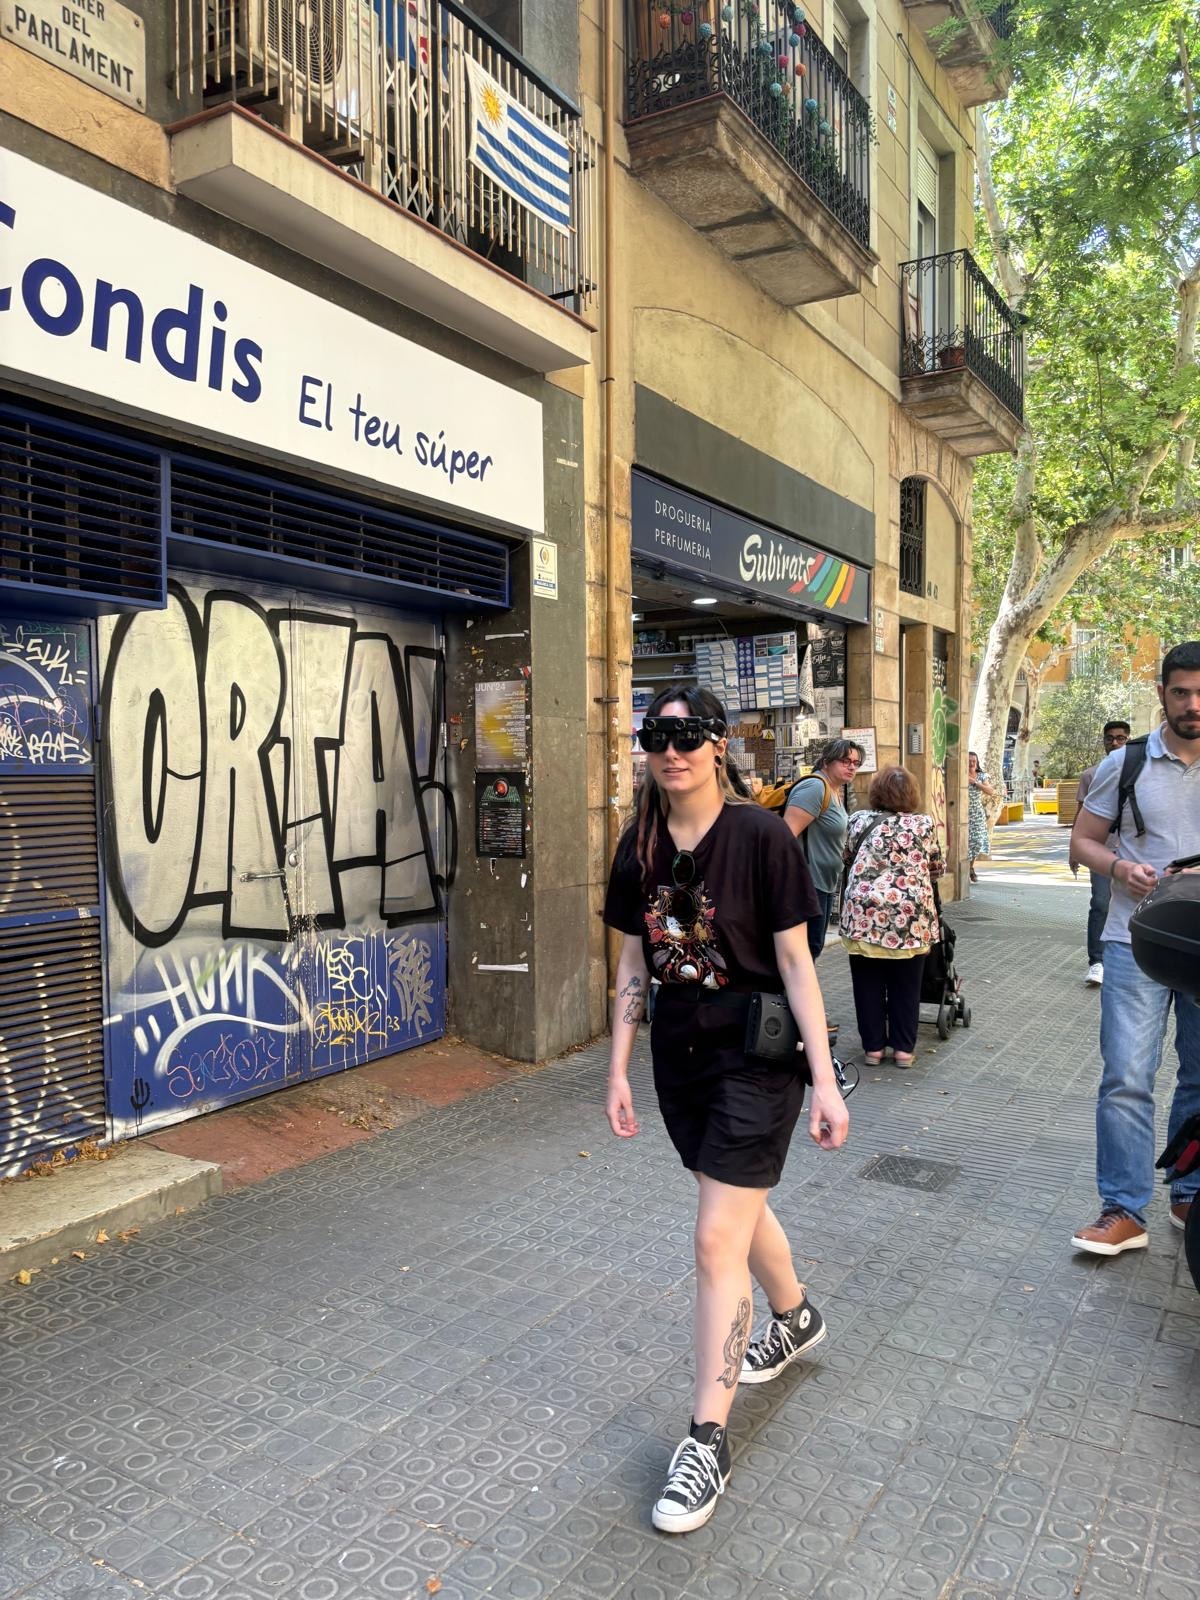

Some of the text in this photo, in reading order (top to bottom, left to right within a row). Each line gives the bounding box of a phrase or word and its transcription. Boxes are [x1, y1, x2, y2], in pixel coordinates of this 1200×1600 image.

[62, 5, 91, 38] DEL
[14, 4, 134, 93] PARLAMENT
[0, 202, 494, 485] ondis El teu súper
[655, 499, 712, 535] DROGUERIA
[655, 528, 712, 561] PERFUMERIA
[739, 534, 816, 585] Subirats
